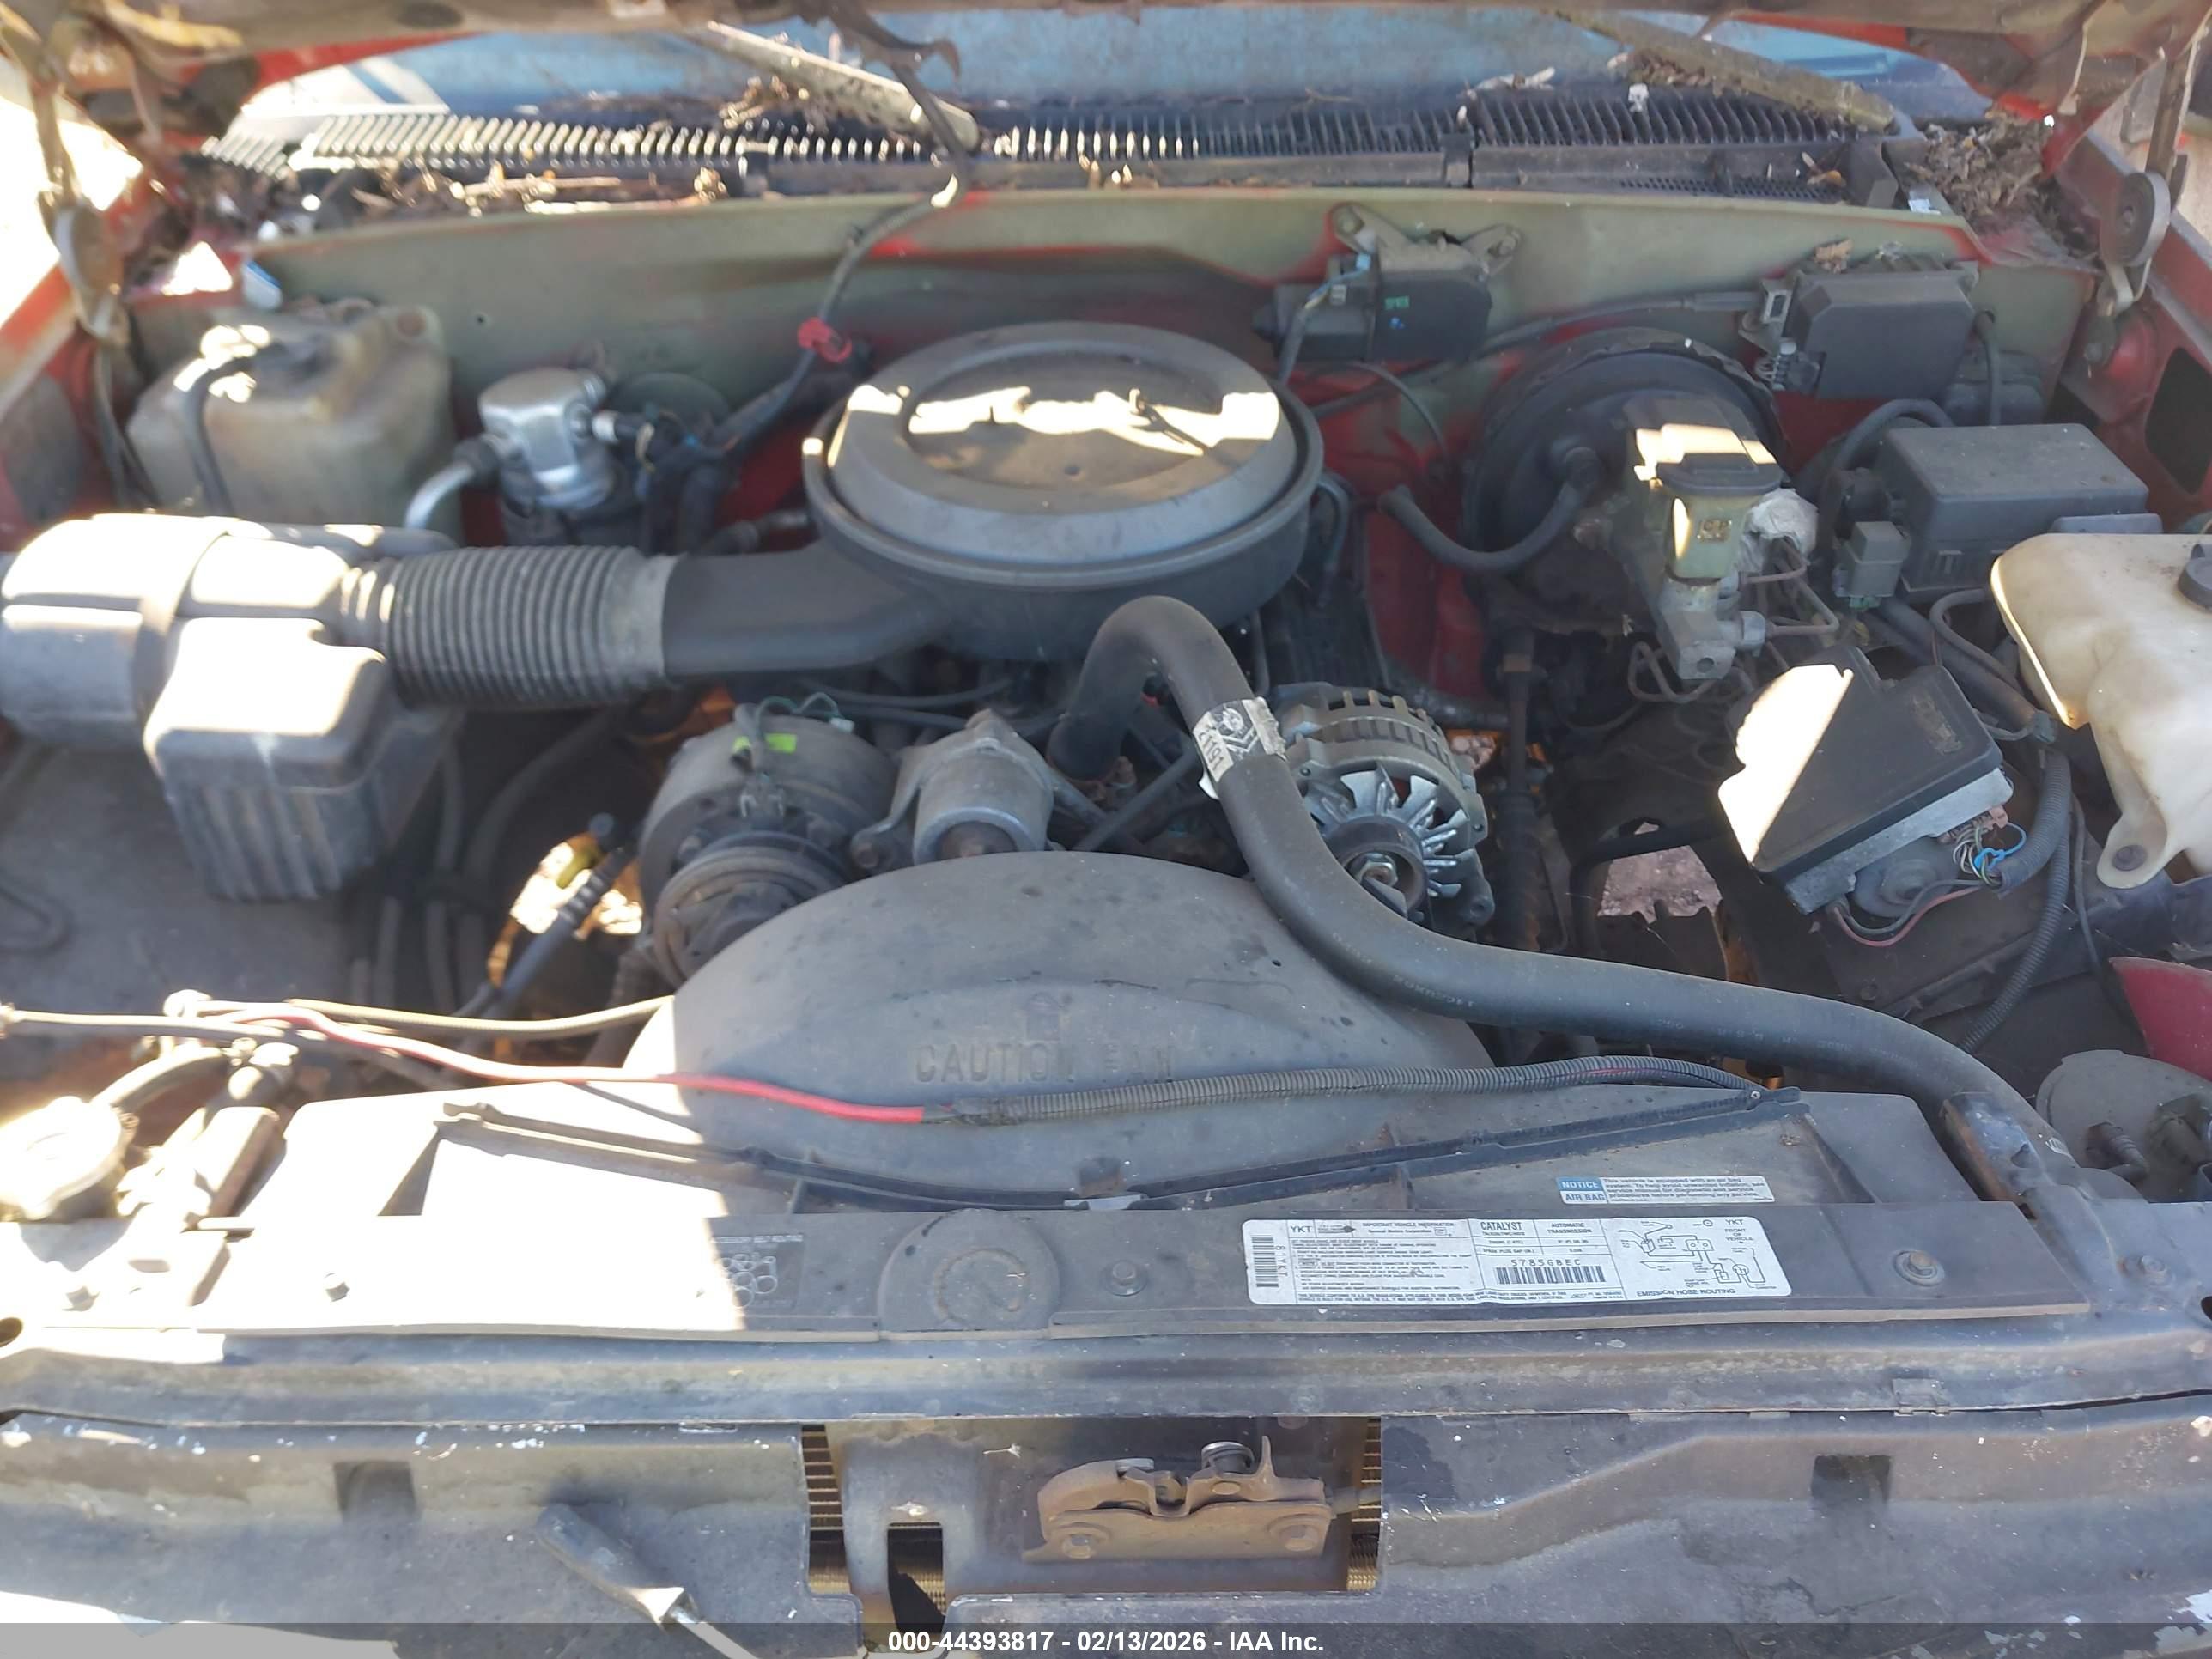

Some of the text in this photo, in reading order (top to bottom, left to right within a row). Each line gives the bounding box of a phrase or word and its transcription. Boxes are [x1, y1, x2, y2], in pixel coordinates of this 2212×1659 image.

[915, 1043, 1075, 1082] CAUTION
[1290, 1225, 1312, 1234] YKT
[1480, 1221, 1522, 1231] CATALYST
